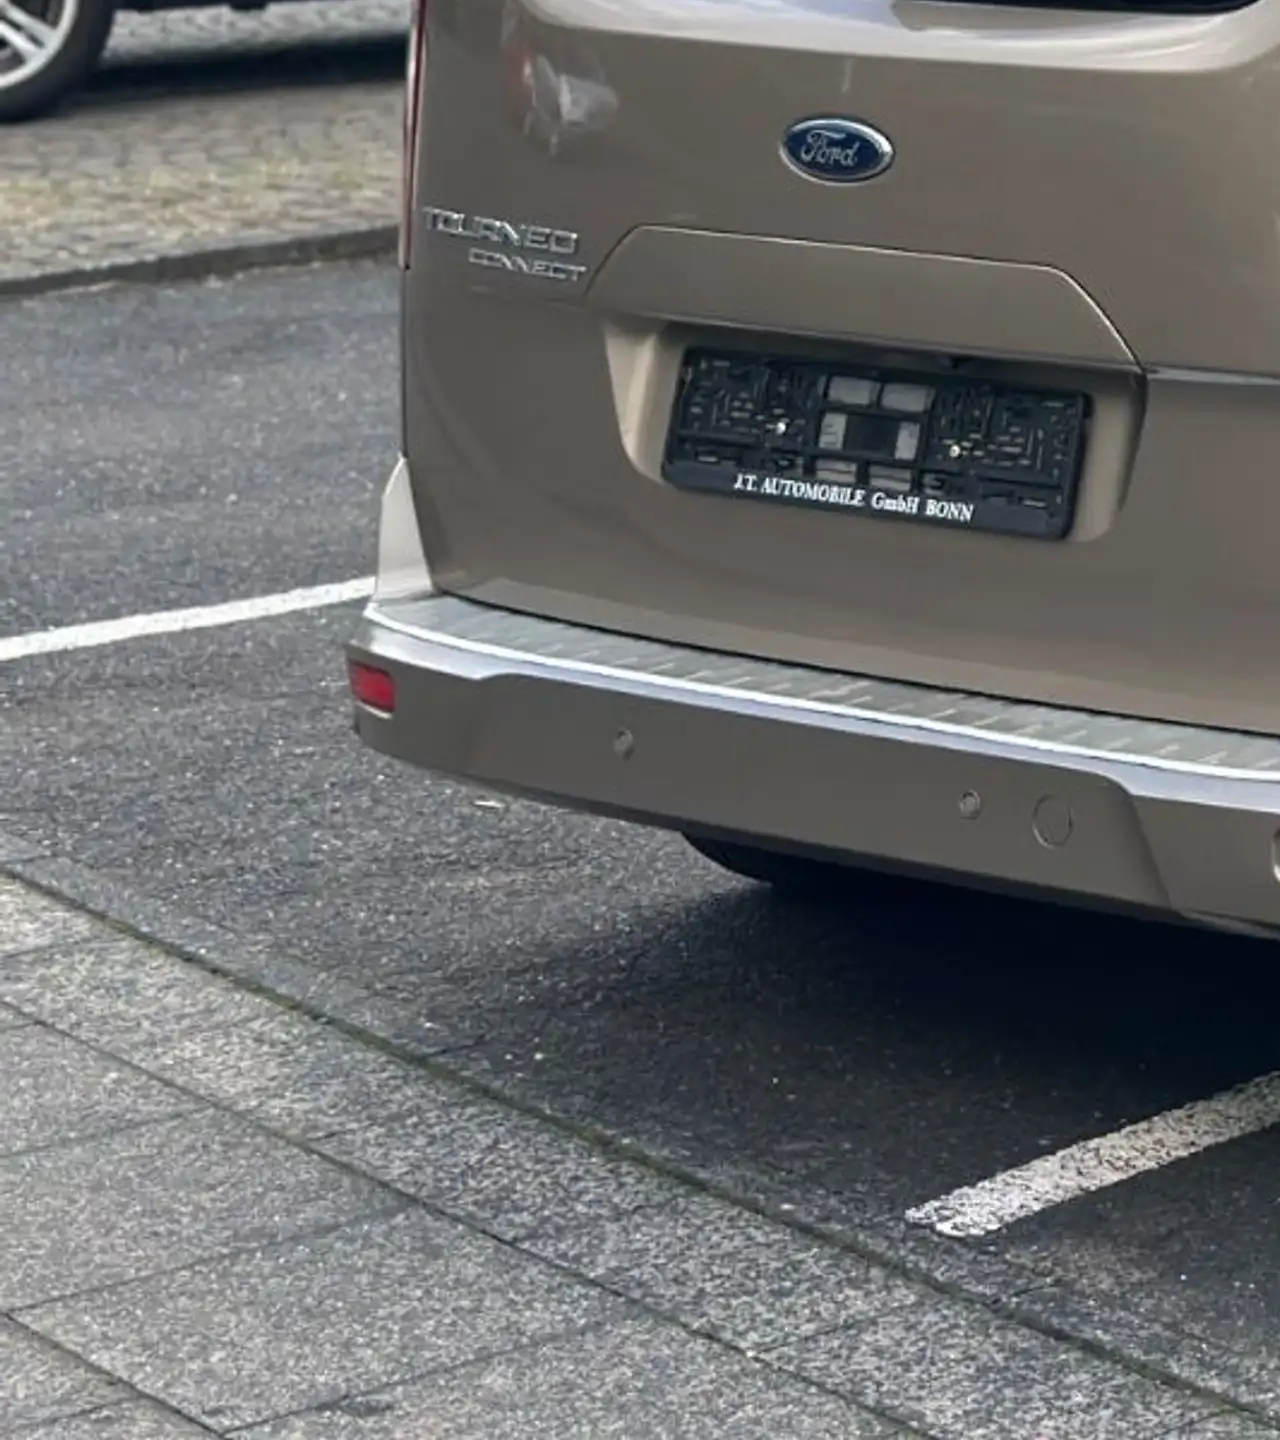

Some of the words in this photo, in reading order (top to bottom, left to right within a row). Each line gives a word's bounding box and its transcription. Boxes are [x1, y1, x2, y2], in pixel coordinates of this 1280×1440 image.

[800, 128, 861, 166] Ford
[422, 207, 578, 253] TOURNEO
[468, 247, 587, 282] CONNECT
[760, 477, 866, 507] AUTOMOBILE
[871, 492, 920, 515] GmbH
[924, 499, 974, 522] BONN
